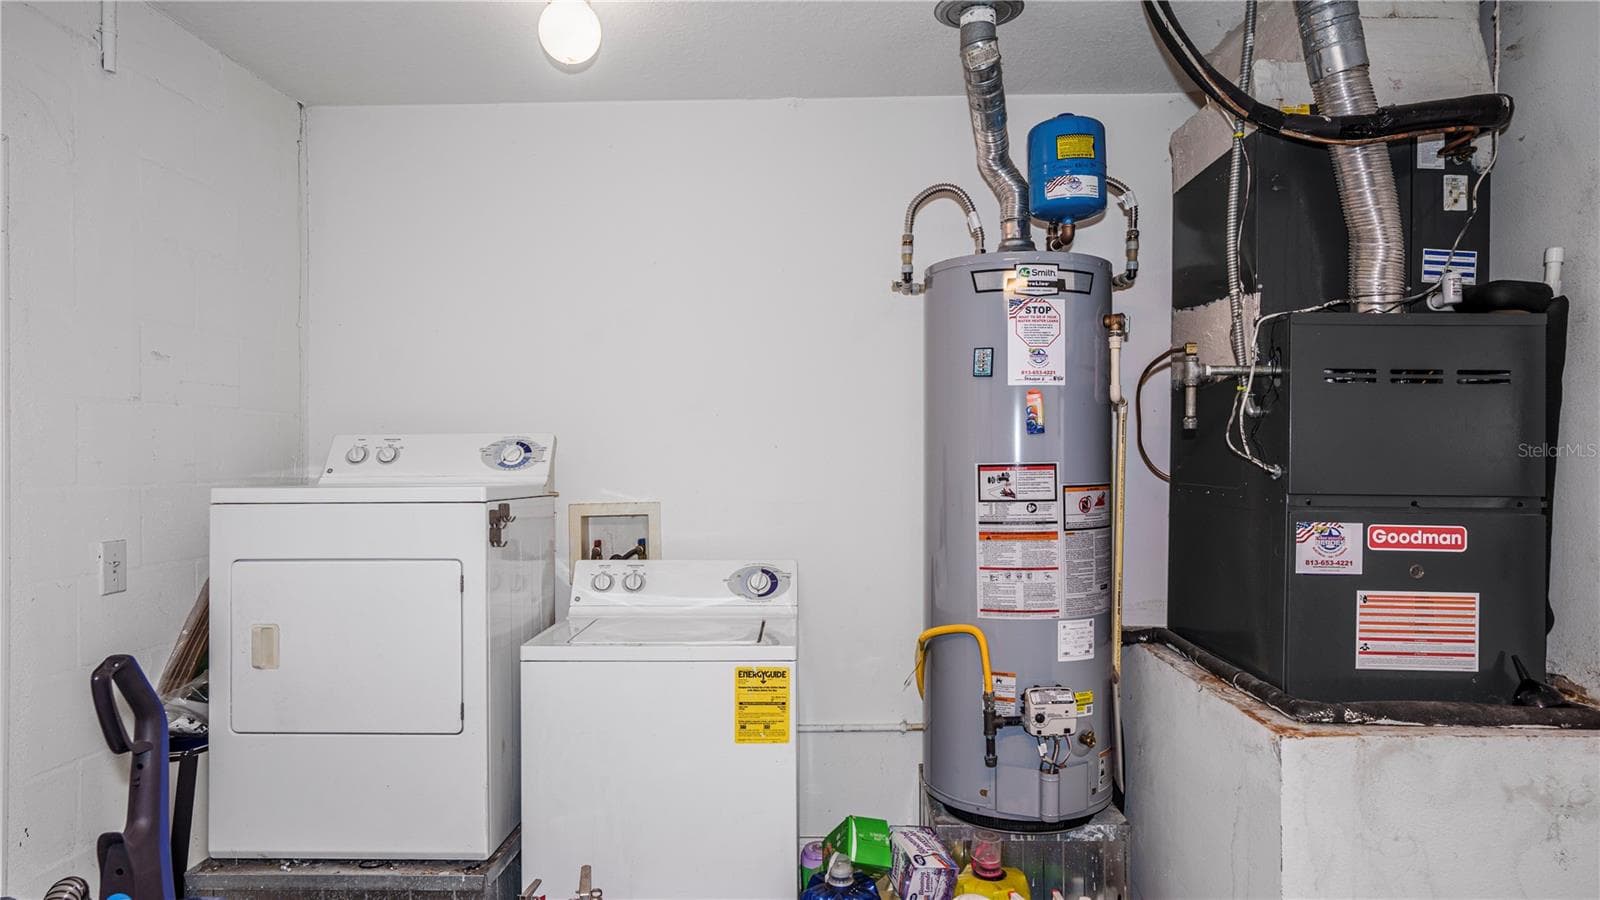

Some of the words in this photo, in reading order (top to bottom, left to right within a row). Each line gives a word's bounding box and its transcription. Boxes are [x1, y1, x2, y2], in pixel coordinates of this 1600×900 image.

[1031, 269, 1056, 277] Smith
[1025, 306, 1051, 314] STOP
[1372, 529, 1462, 545] Goodman
[738, 670, 787, 680] ENERGYGUIDE
